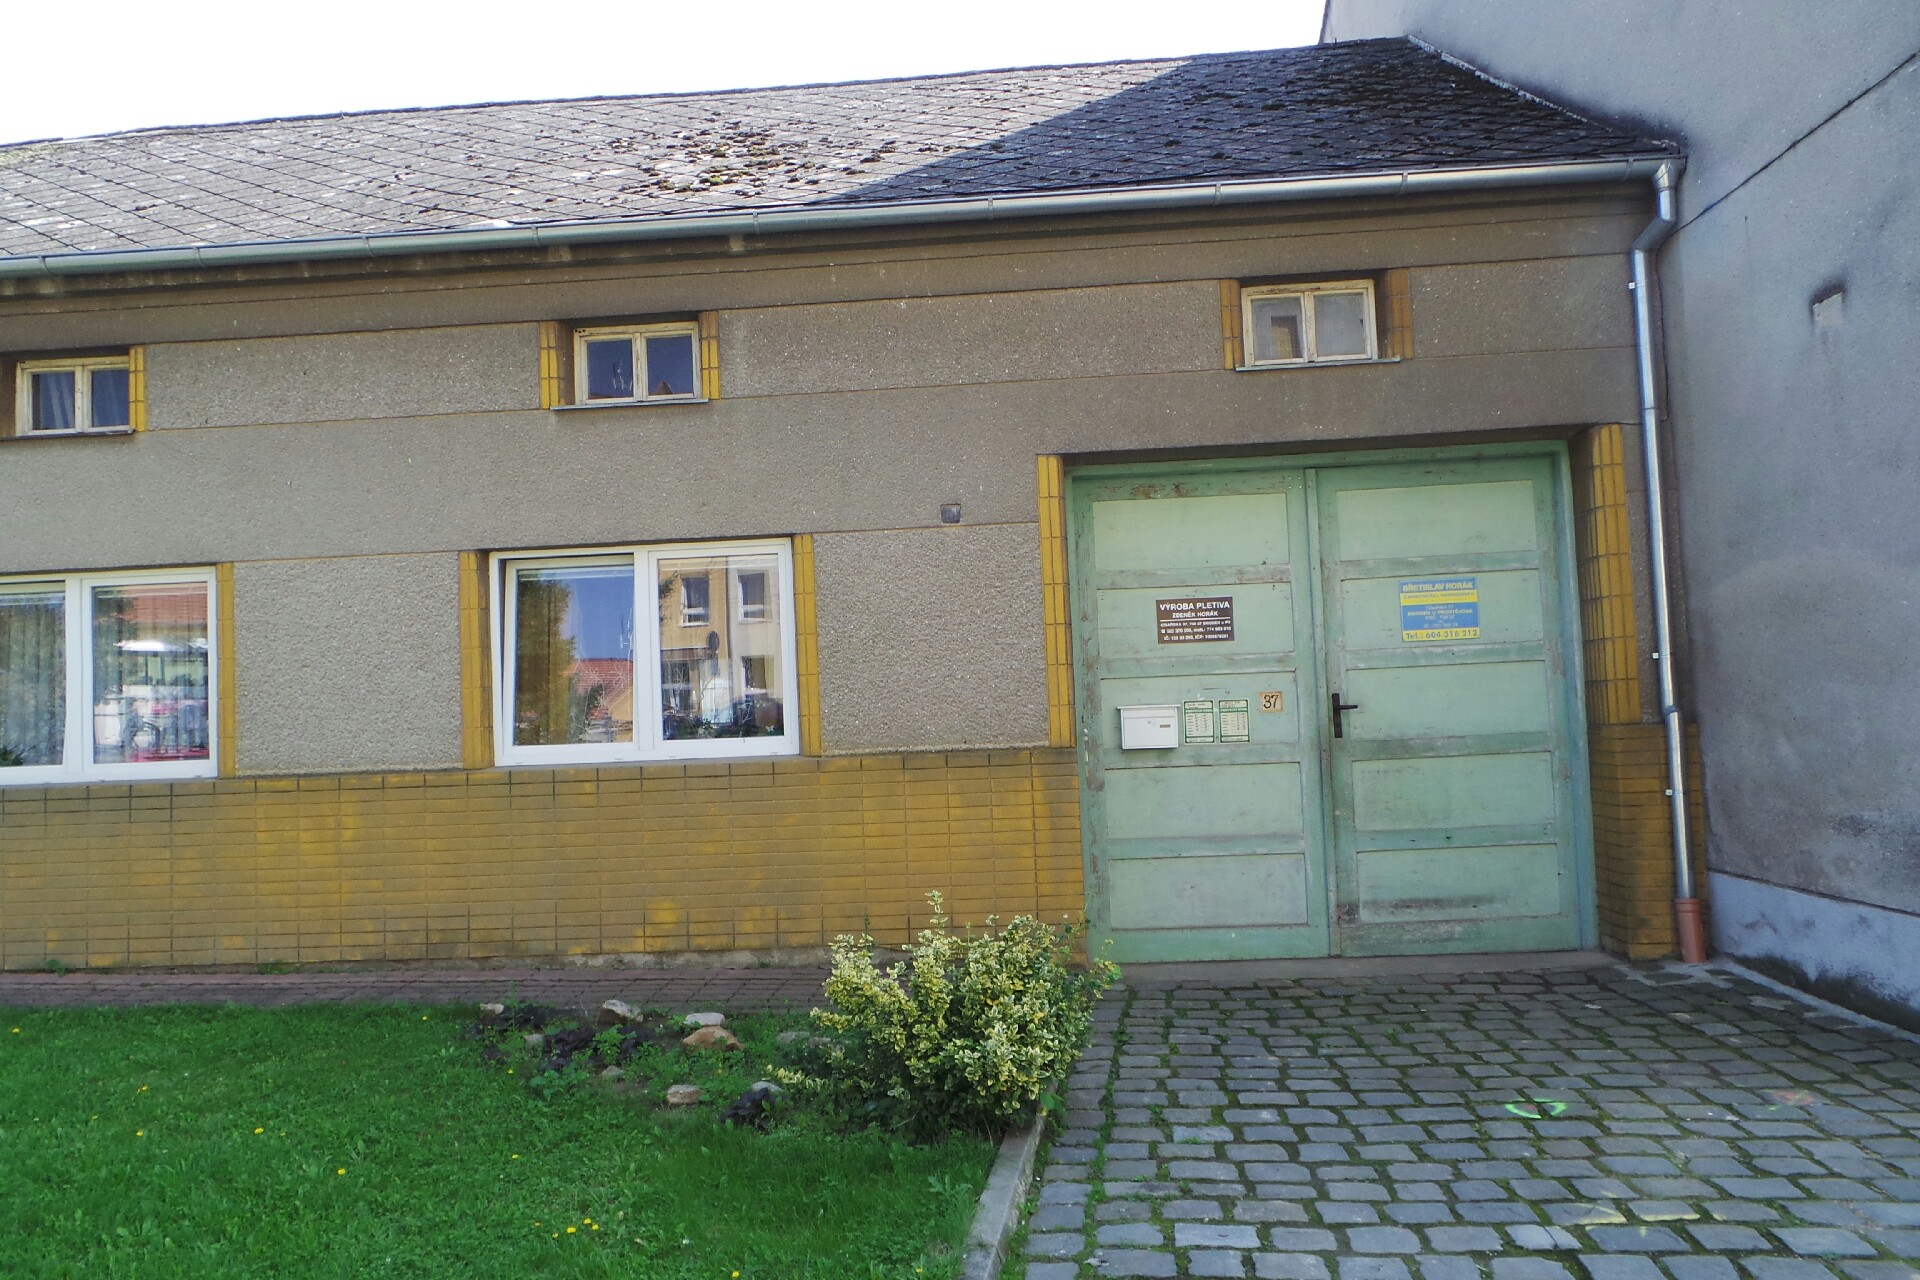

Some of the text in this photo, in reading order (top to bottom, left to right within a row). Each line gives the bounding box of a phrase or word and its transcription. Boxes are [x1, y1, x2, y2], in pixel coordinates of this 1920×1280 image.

[1402, 581, 1473, 592] BŘETISLAV HORÁK
[1160, 601, 1230, 611] VÝROBA PLETIVA
[1426, 631, 1441, 639] 604
[1444, 630, 1459, 638] 316
[1462, 629, 1478, 637] 212
[1263, 694, 1279, 709] 37
